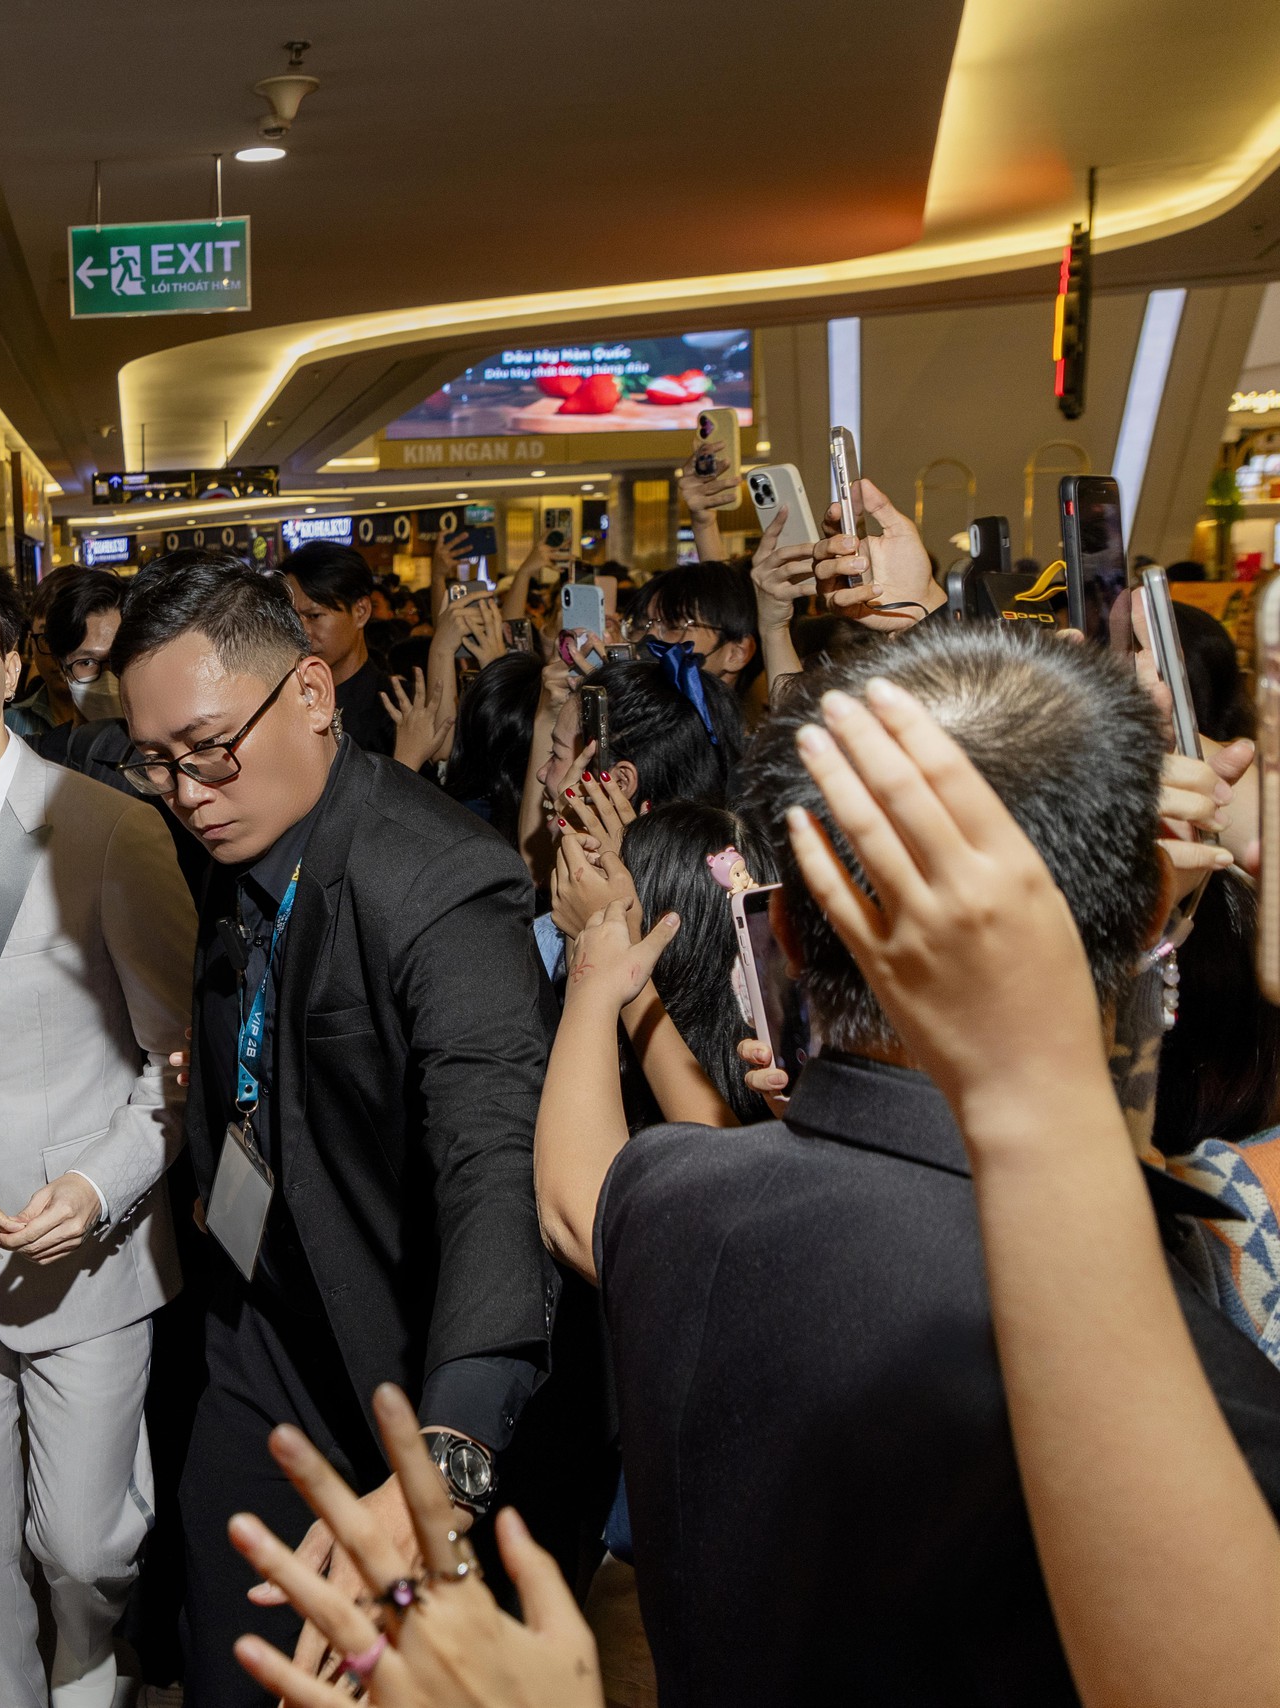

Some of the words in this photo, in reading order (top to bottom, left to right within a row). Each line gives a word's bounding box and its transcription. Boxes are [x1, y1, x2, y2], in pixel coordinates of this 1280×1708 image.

[151, 241, 240, 275] EXIT
[172, 279, 209, 292] THOÁT
[403, 444, 444, 464] KIM
[449, 441, 509, 462] NGAN
[515, 440, 545, 460] AD
[251, 1011, 262, 1037] VIP
[246, 1037, 257, 1058] 2B
